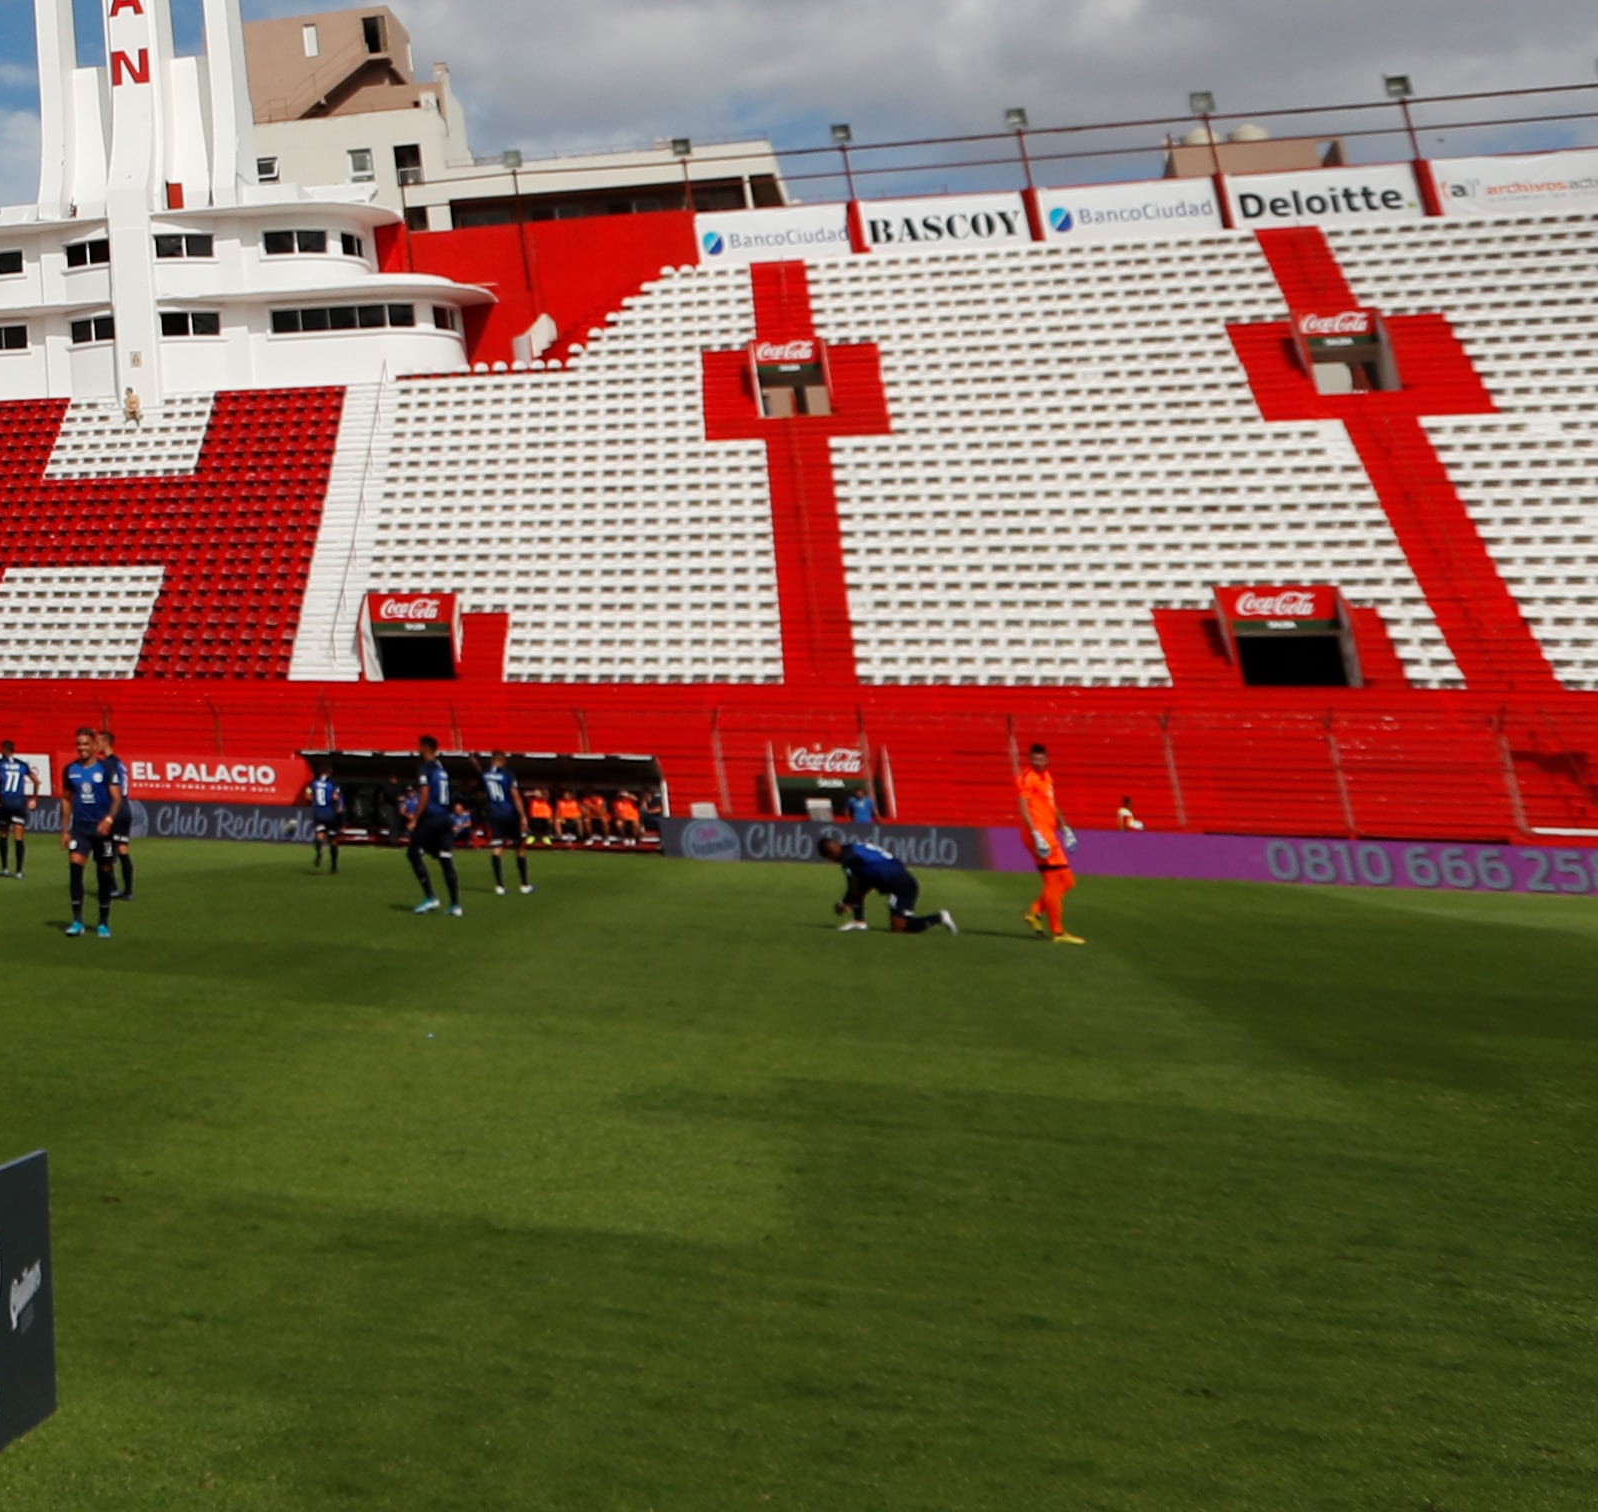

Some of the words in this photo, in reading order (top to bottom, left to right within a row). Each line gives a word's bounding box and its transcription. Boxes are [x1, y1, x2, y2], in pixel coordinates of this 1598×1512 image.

[869, 210, 1021, 244] BASCOY
[1079, 198, 1214, 225] BancoCiudad
[730, 224, 848, 248] BancoCiudad
[131, 761, 160, 780] EL
[166, 762, 276, 785] PALACIO
[156, 806, 208, 837] Club
[745, 821, 812, 859] Club
[1266, 838, 1392, 886] 0810
[1405, 846, 1513, 890] 666
